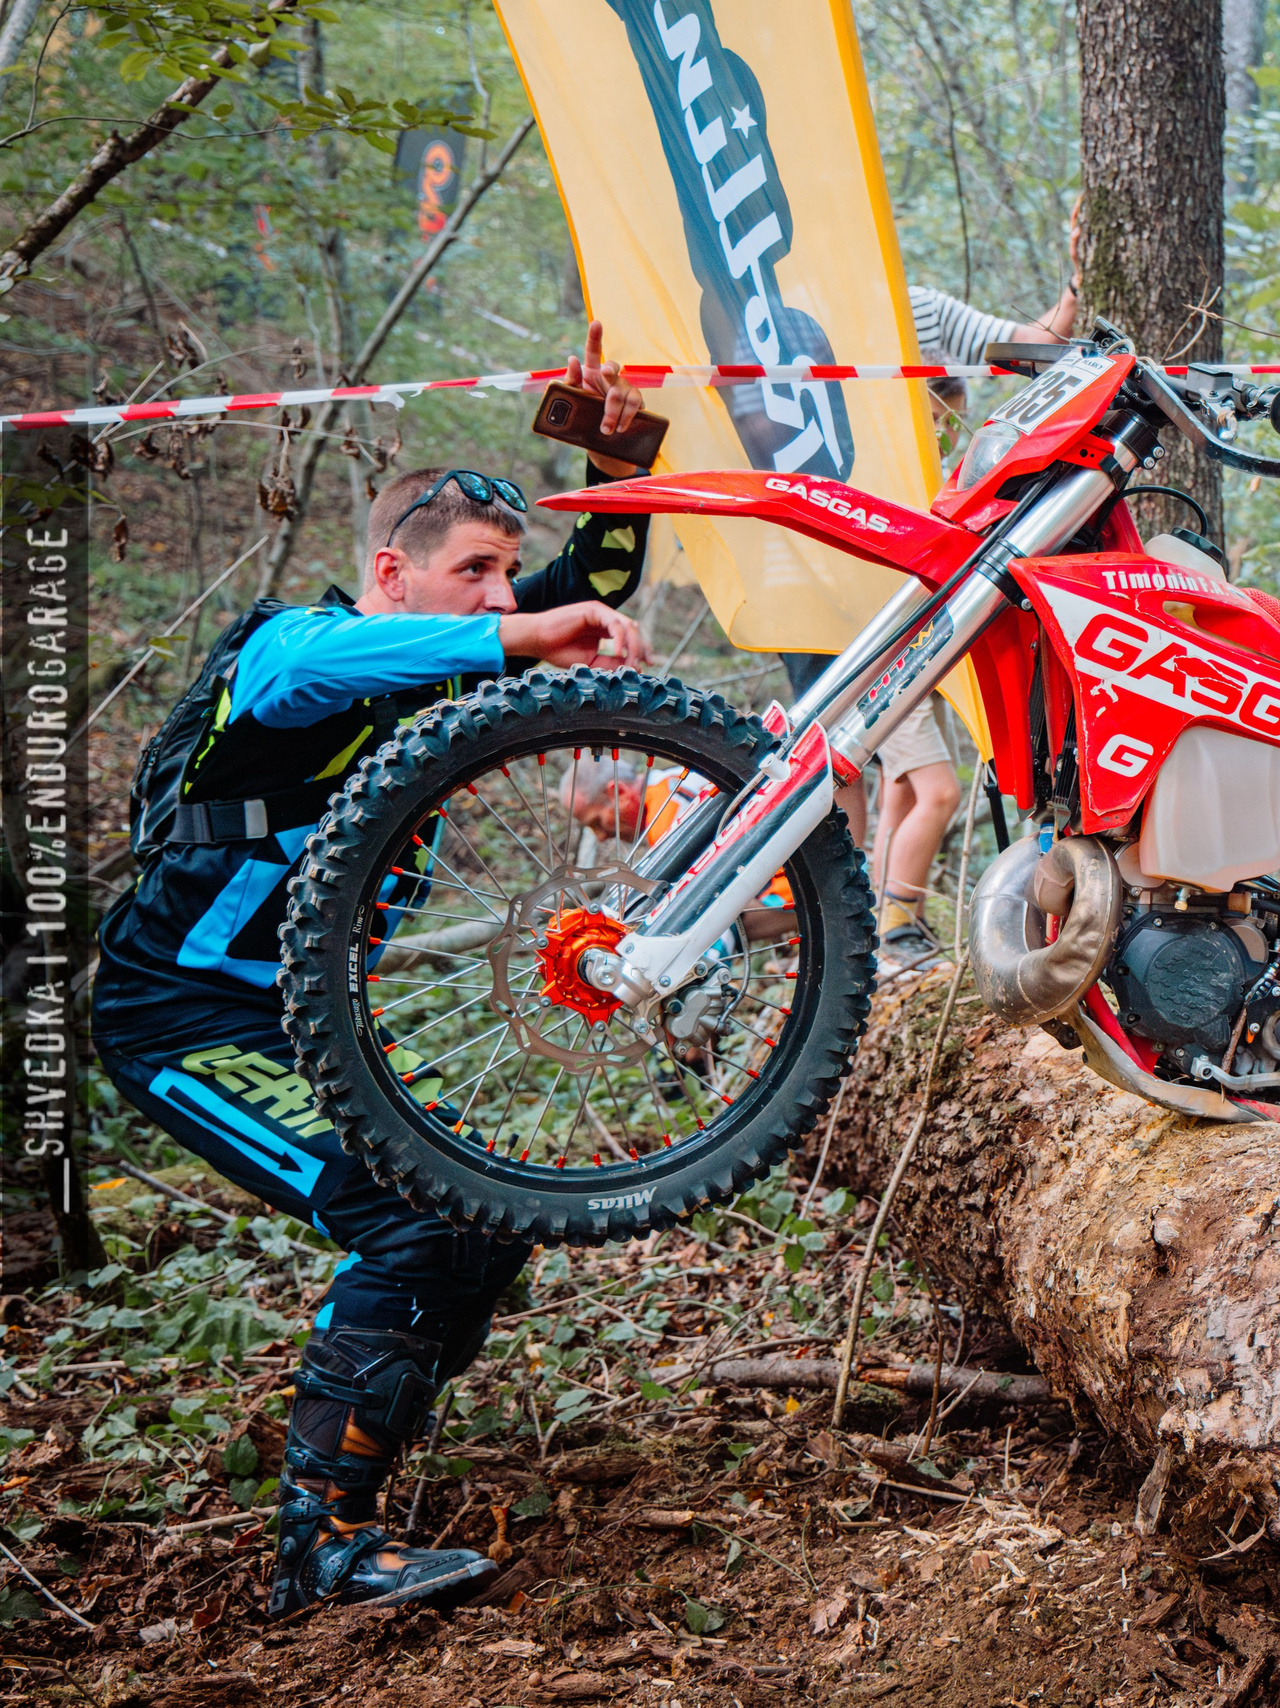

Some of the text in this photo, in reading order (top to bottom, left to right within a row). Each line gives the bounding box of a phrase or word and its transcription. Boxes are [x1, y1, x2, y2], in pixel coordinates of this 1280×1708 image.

[765, 477, 890, 533] GASGAS
[1102, 571, 1199, 590] Timonin
[349, 943, 360, 992] EXCEL
[588, 1186, 657, 1210] Mitas
